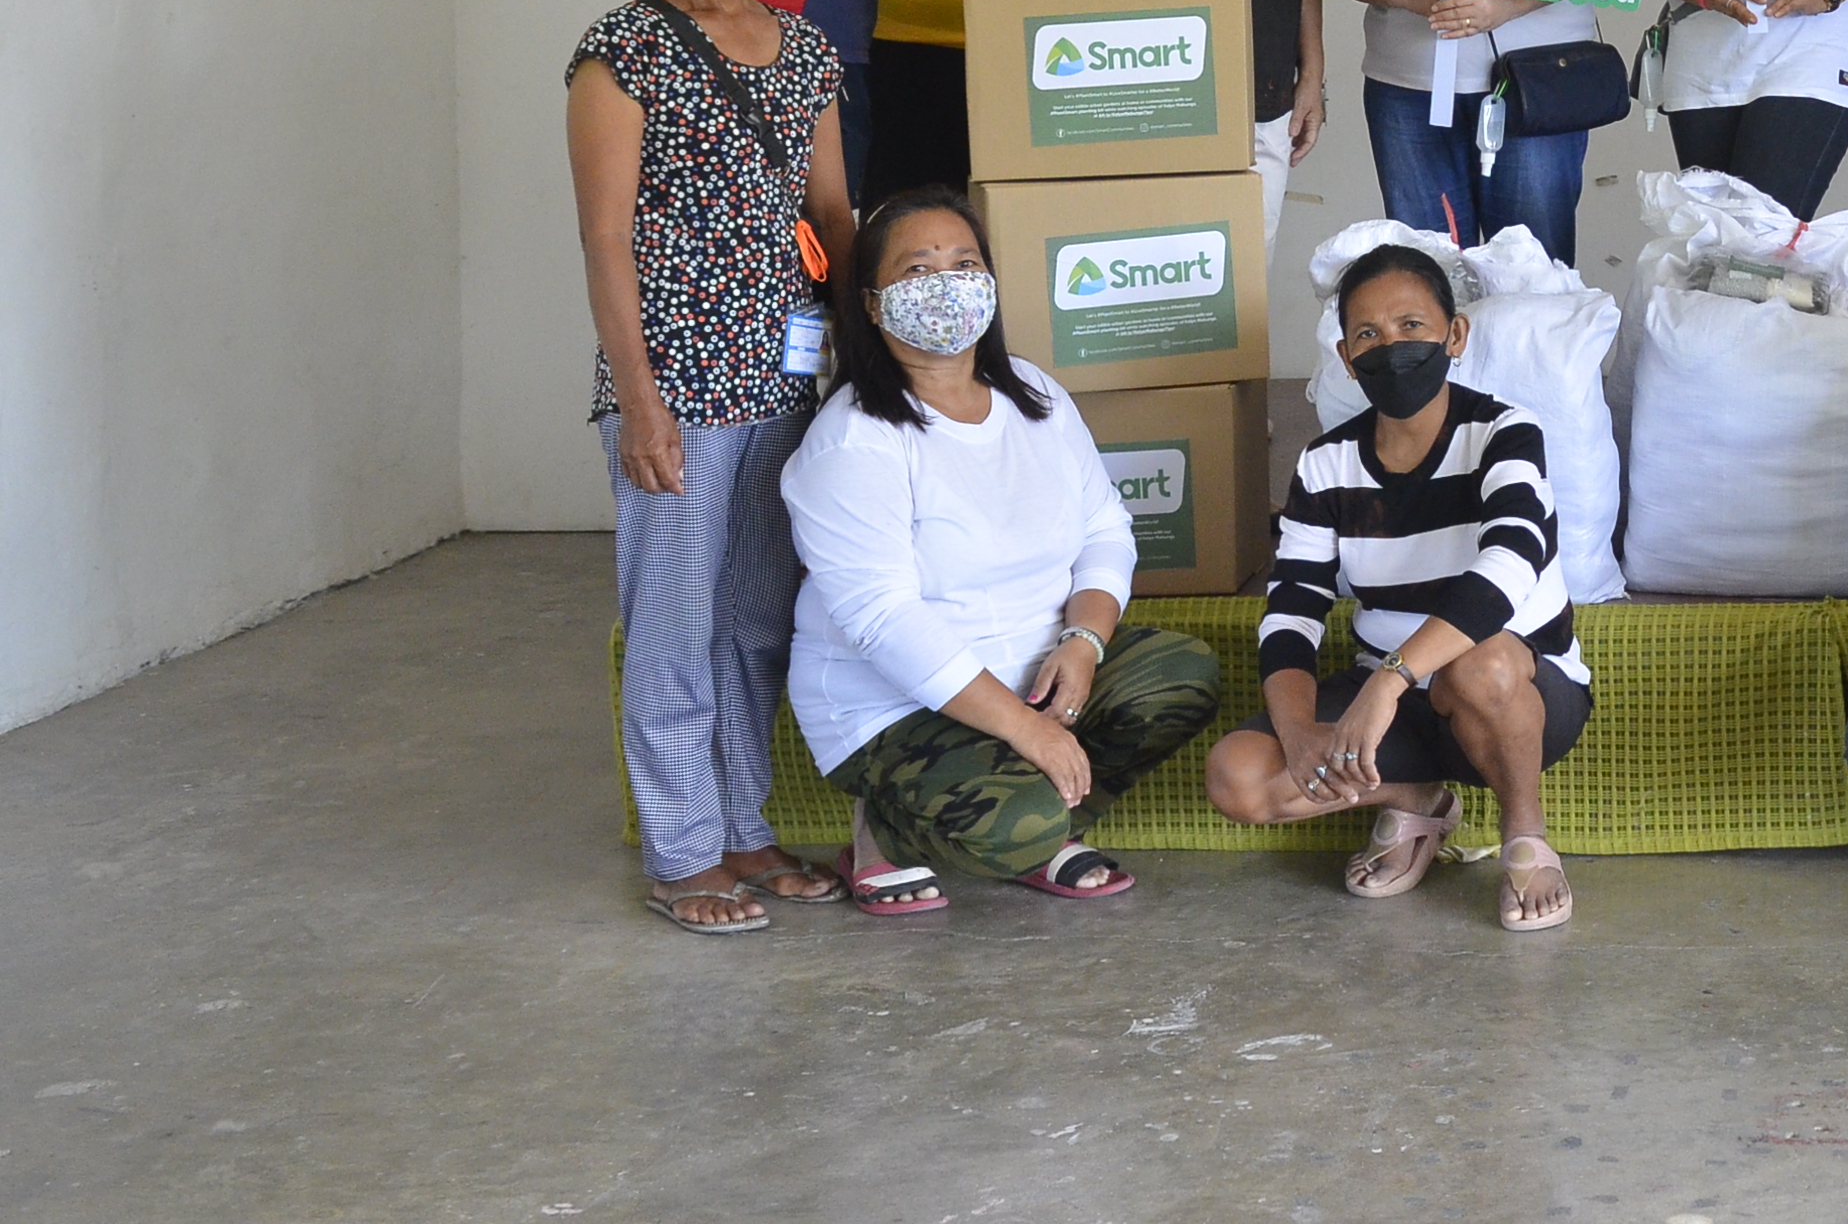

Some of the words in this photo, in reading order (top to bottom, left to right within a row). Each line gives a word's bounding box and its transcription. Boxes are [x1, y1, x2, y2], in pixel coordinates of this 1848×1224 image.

[1088, 36, 1192, 71] Smart
[1110, 251, 1212, 290] Smart
[1117, 469, 1171, 500] art
